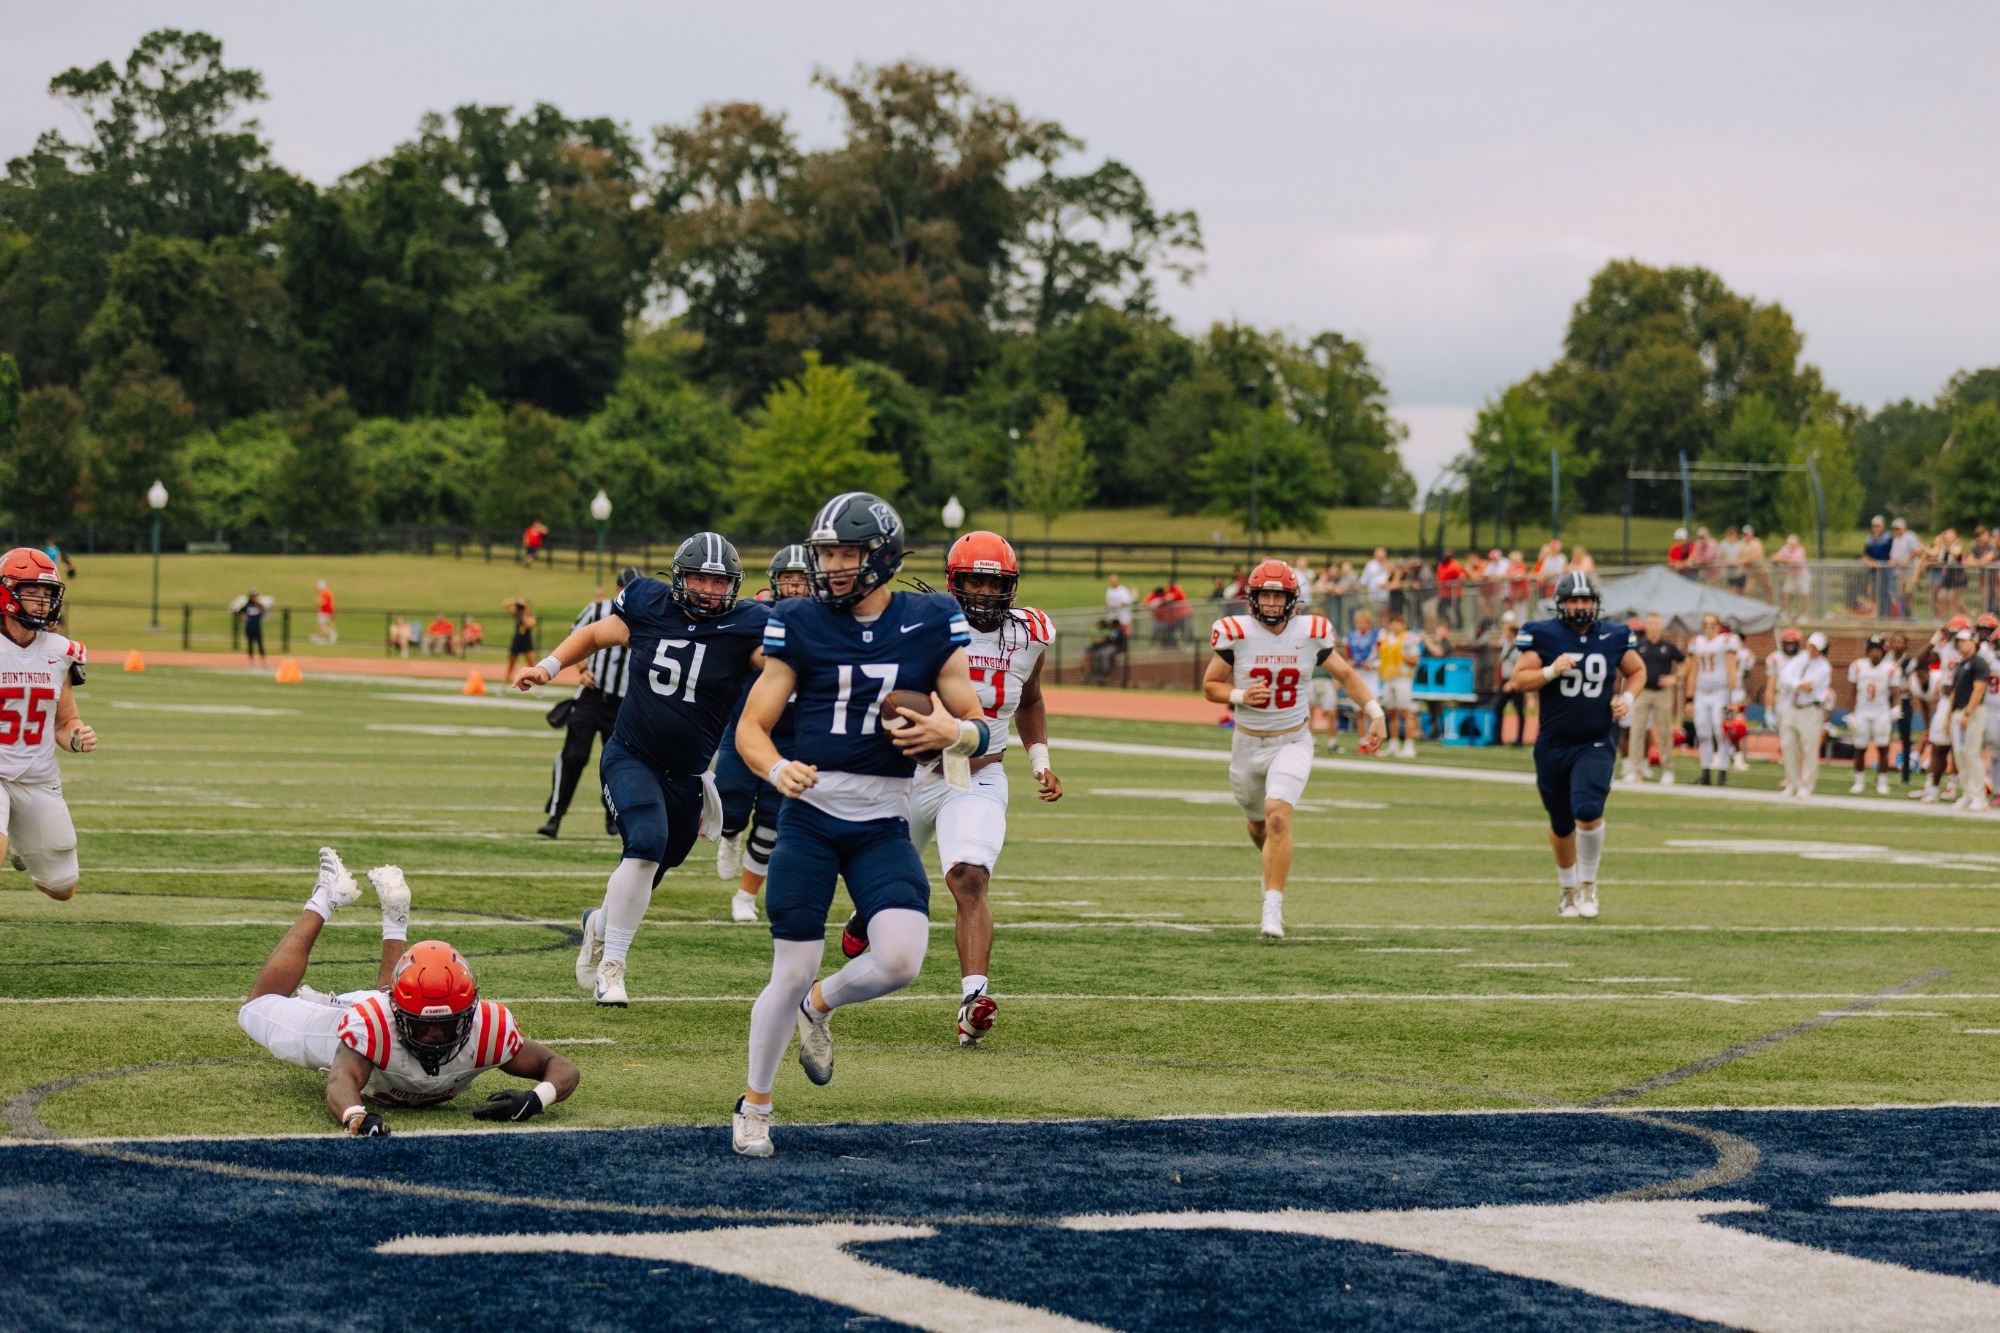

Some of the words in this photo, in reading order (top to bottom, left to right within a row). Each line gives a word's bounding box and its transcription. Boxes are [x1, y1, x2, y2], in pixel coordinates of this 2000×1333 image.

[2, 672, 51, 684] HUNTINGDON
[649, 639, 706, 703] 51
[966, 655, 1010, 670] NTINGDON
[1255, 655, 1298, 664] HUNTINGDON
[1560, 652, 1607, 698] 59
[0, 687, 54, 746] 55
[830, 664, 899, 734] 17
